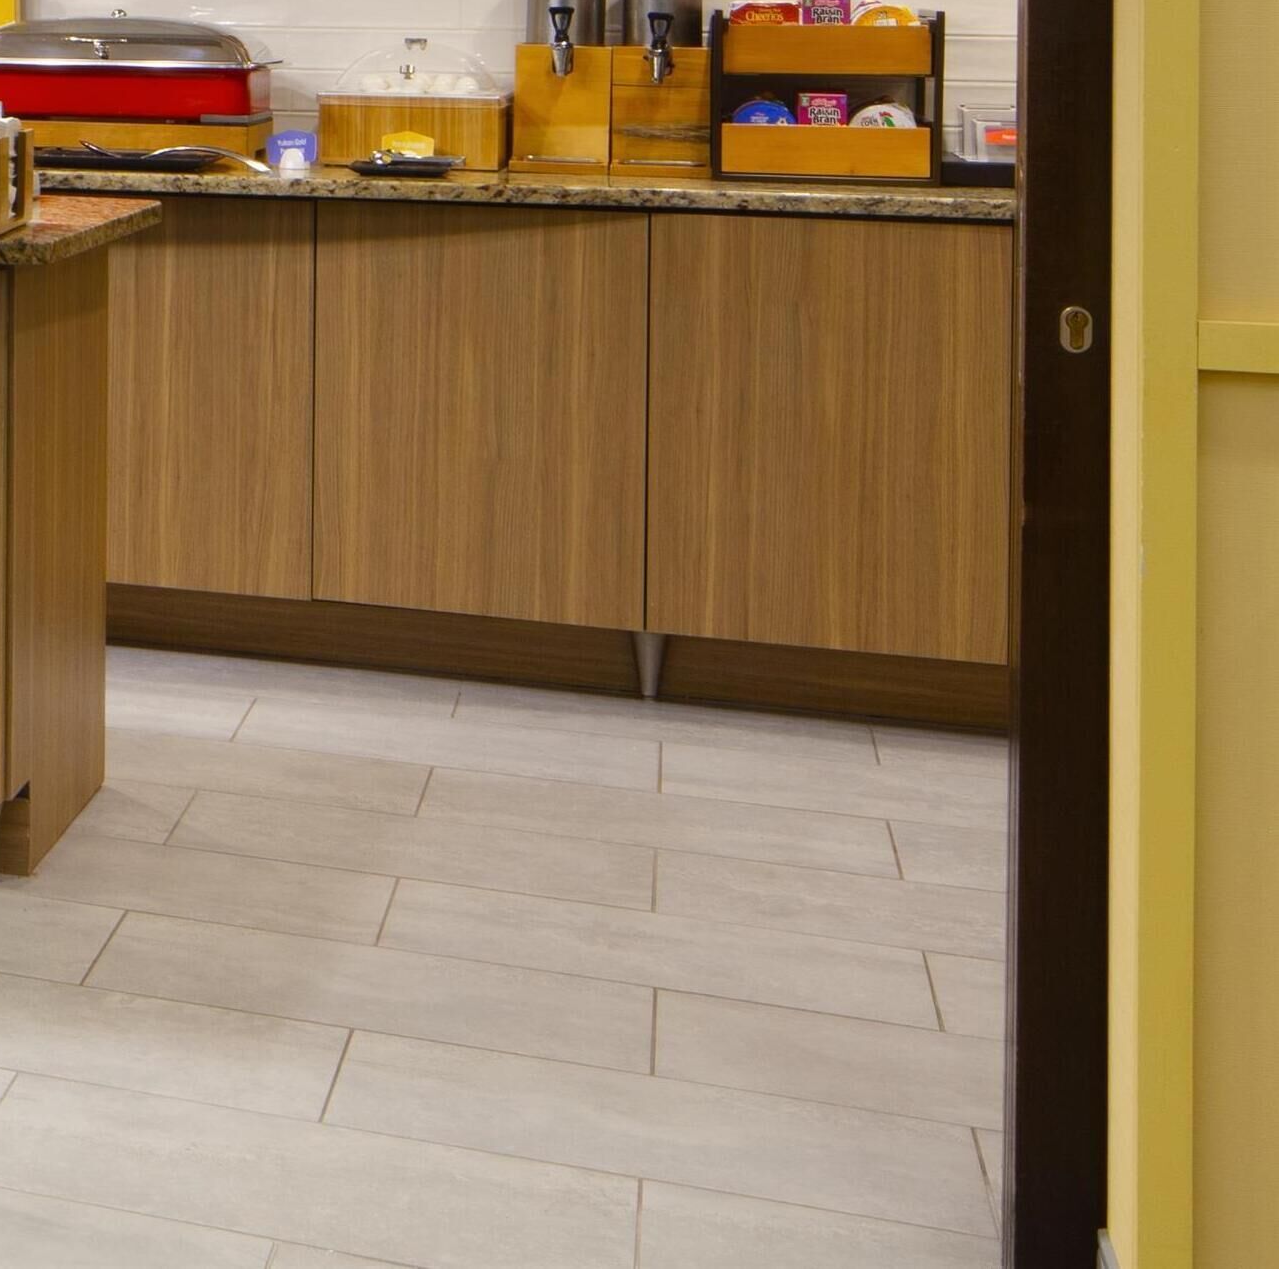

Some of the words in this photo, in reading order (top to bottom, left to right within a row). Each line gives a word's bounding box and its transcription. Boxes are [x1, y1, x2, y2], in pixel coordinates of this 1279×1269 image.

[745, 11, 784, 22] Cheerios
[812, 7, 843, 18] Raisin
[809, 107, 840, 117] Raisin
[813, 115, 837, 124] Bran
